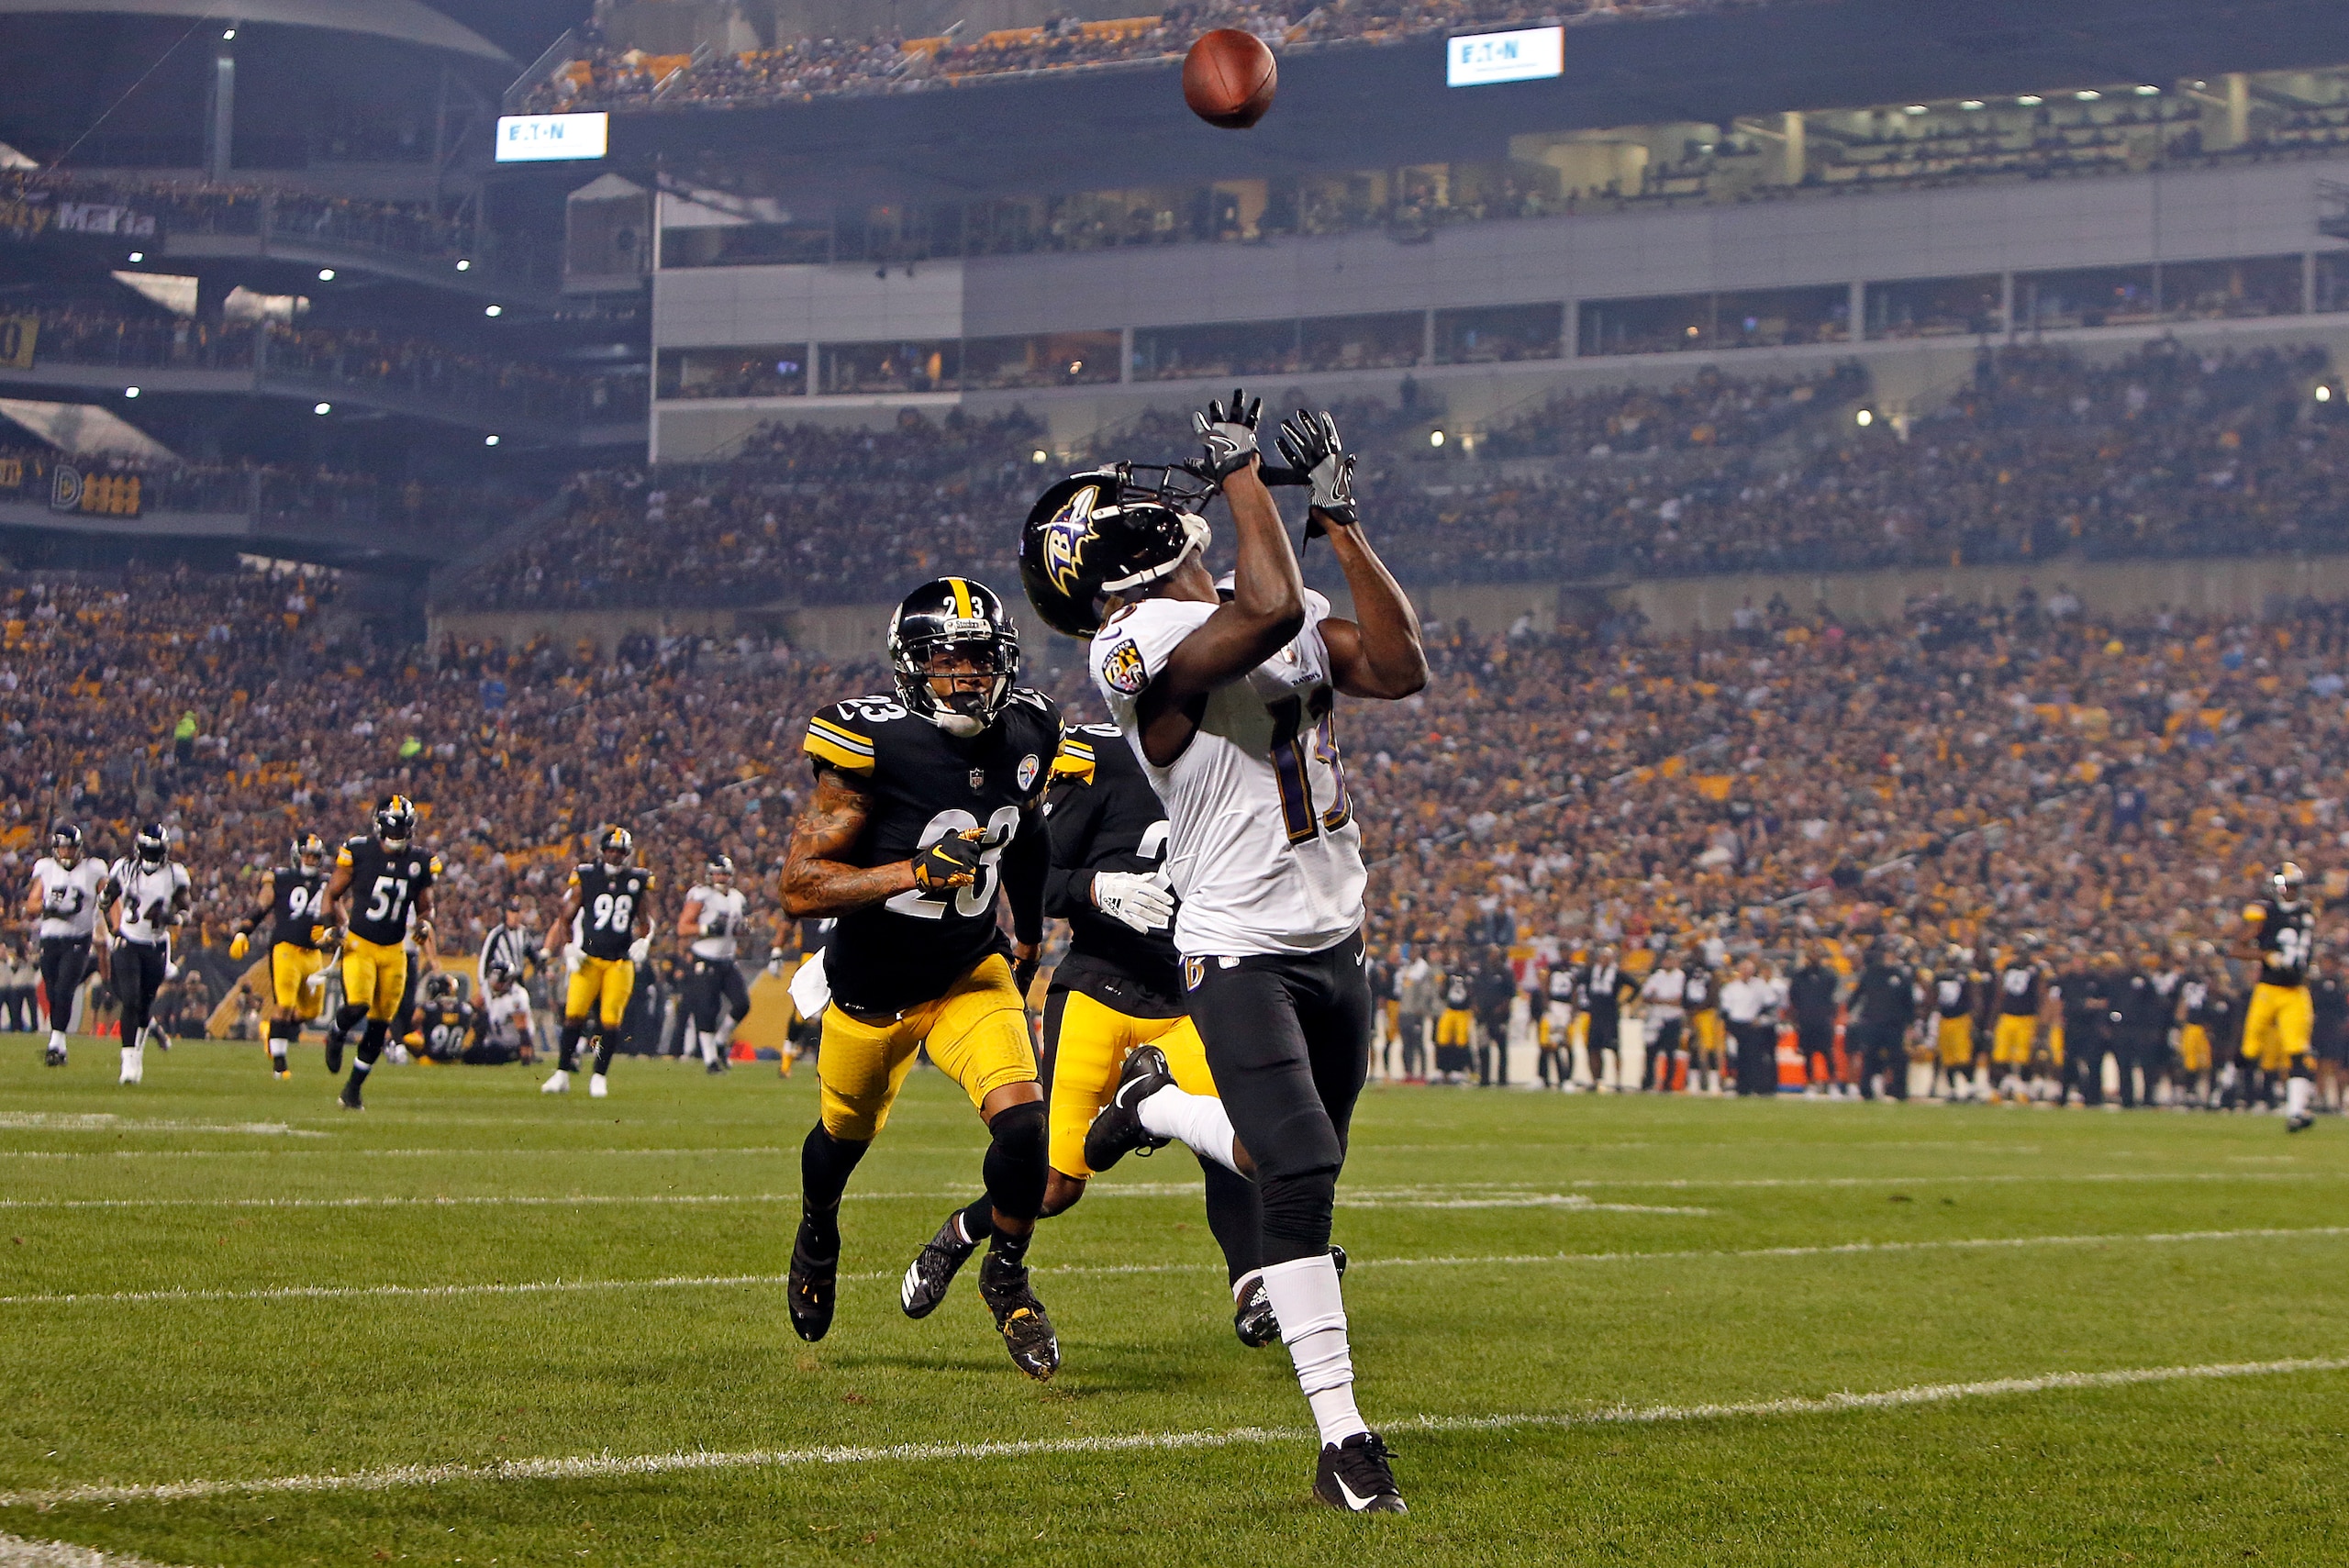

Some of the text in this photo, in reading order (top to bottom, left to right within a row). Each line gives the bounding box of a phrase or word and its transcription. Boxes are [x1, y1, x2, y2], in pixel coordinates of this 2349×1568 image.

[942, 595, 985, 619] 23
[884, 805, 1020, 920] 23
[365, 875, 407, 922] 51
[594, 893, 633, 933] 98
[430, 1024, 465, 1055] 90
